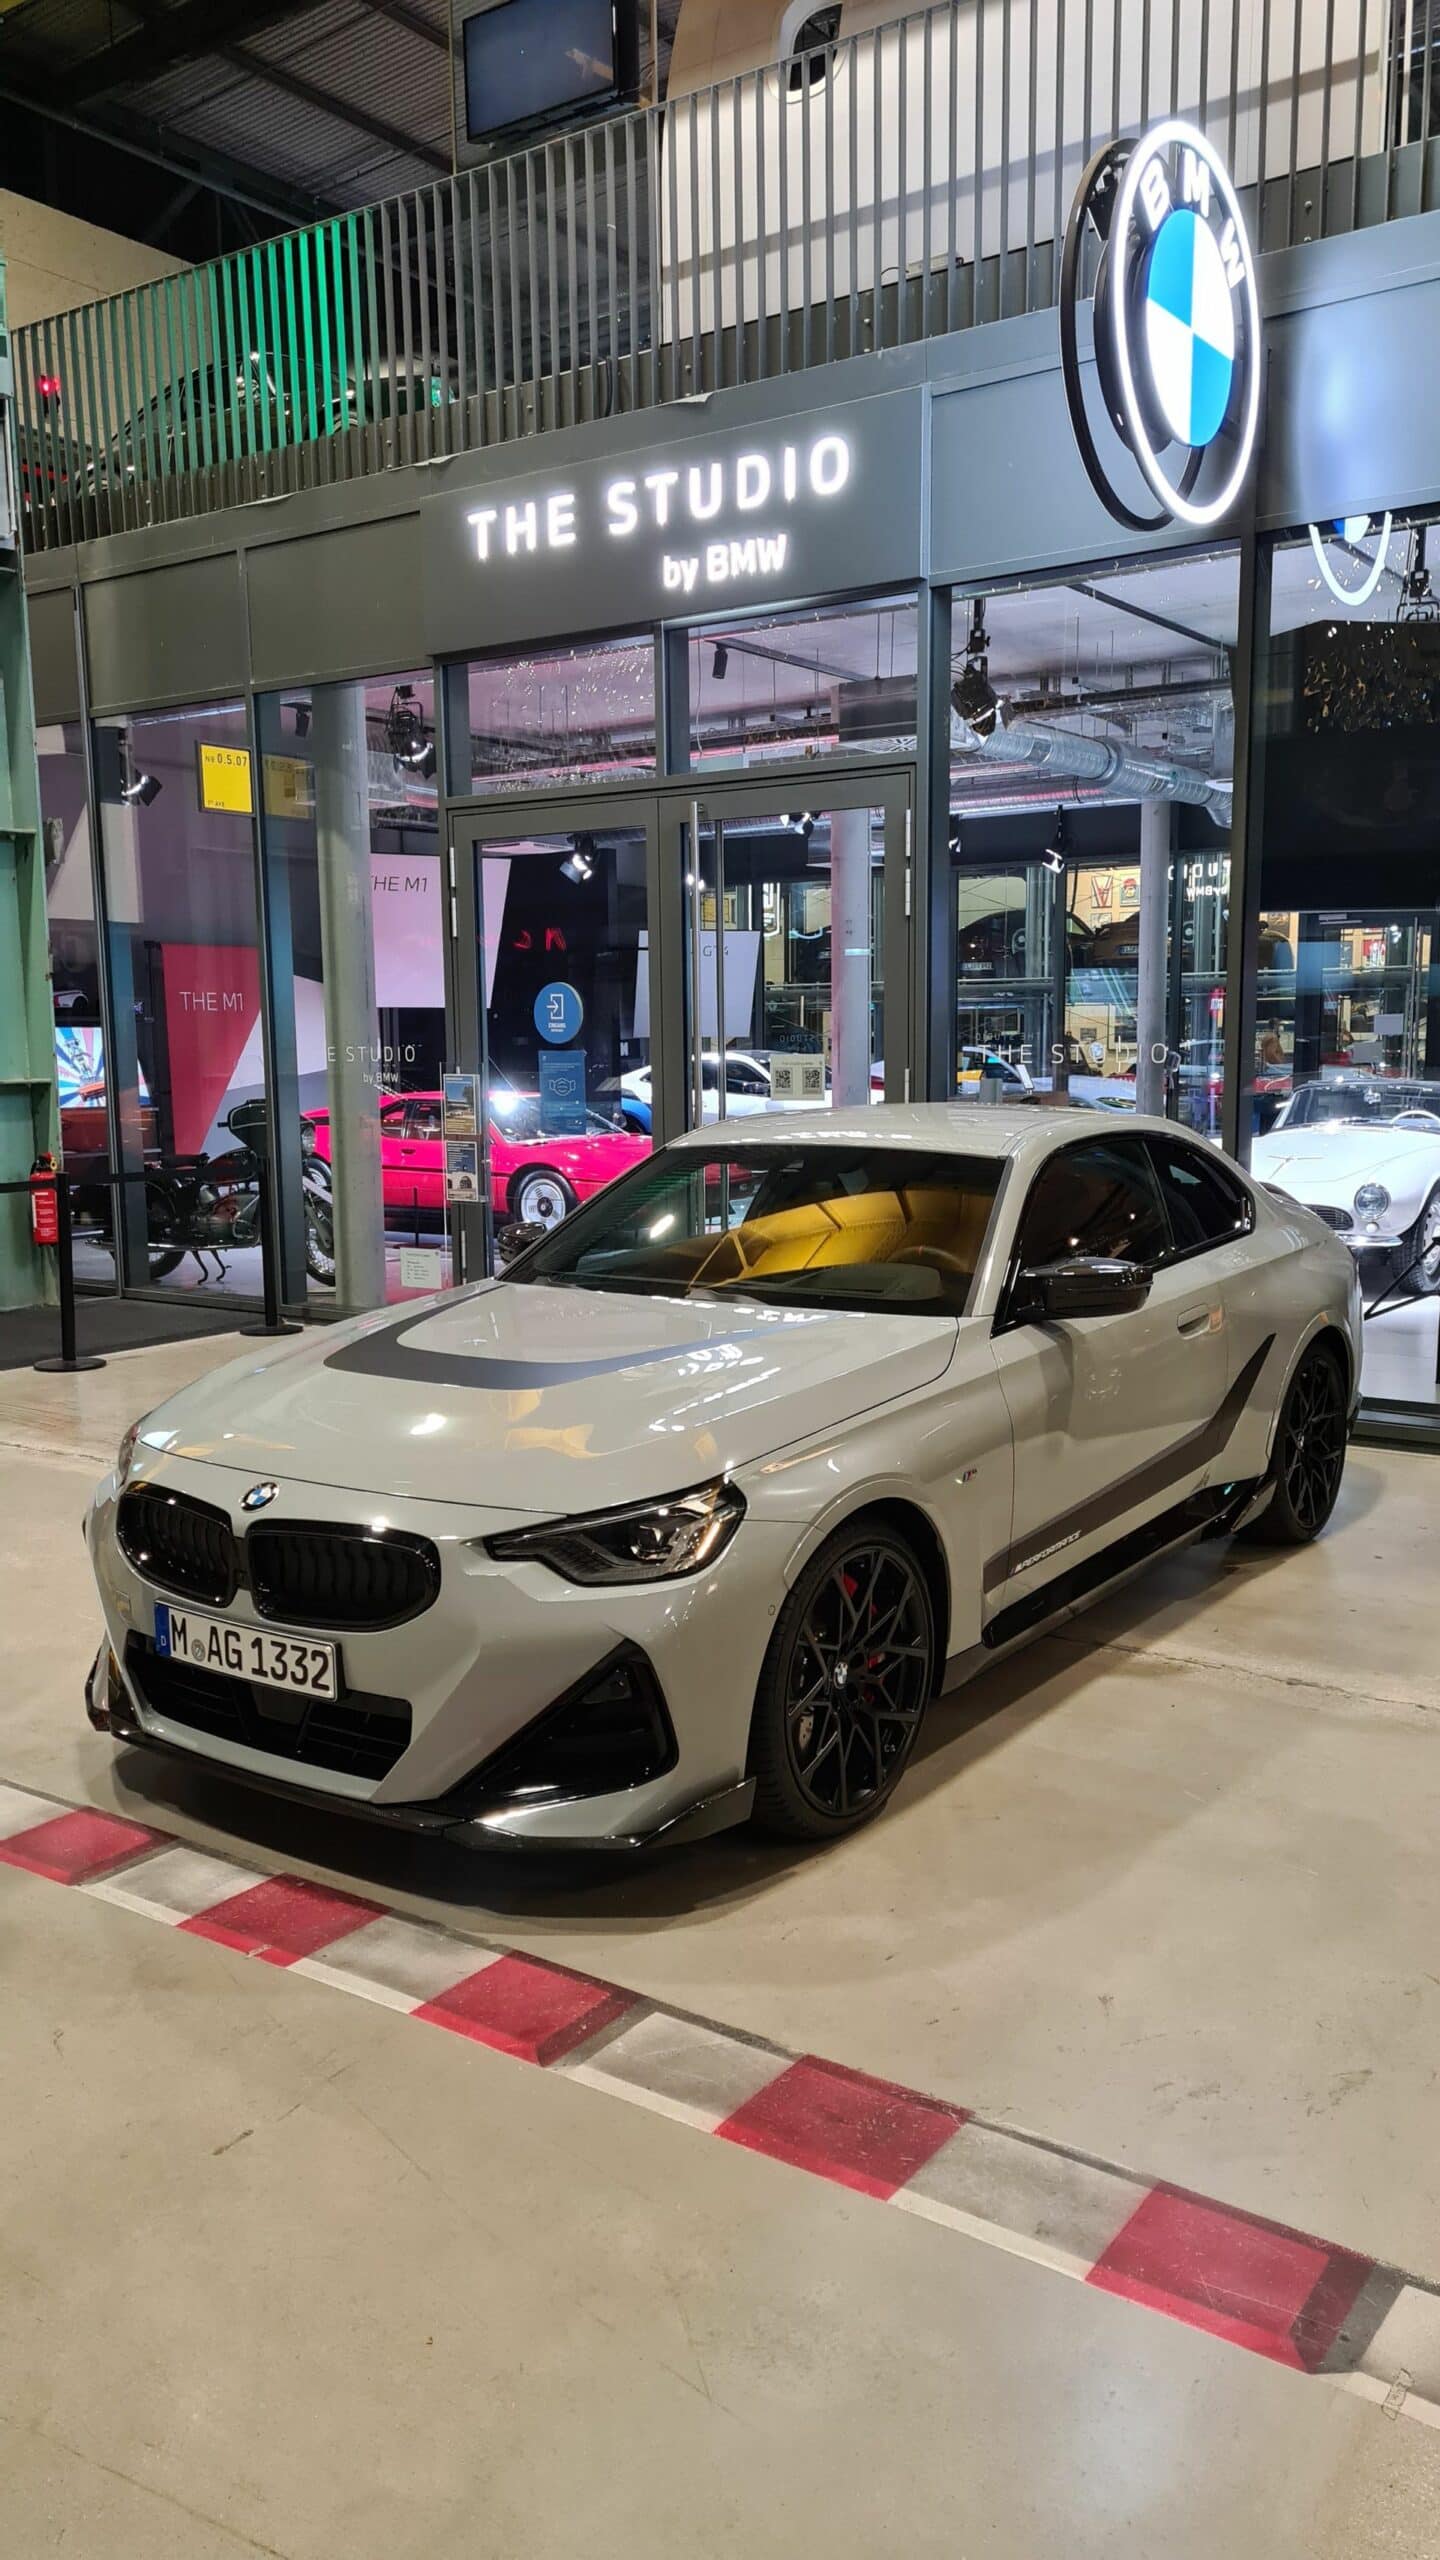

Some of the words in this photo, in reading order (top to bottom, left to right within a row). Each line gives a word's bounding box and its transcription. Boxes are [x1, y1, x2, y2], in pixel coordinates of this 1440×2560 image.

[1139, 148, 1247, 289] BMW
[466, 492, 577, 562] THE
[605, 435, 851, 537] STUDIO
[662, 554, 699, 593] by
[706, 532, 788, 585] BMW
[216, 752, 248, 767] 0.5.07
[371, 875, 400, 892] HE
[405, 876, 428, 893] M1
[178, 991, 218, 1012] THE
[223, 991, 244, 1013] M1
[345, 1046, 416, 1062] STUDIO
[978, 1043, 1033, 1064] THE
[1051, 1043, 1168, 1064] STUDIO
[376, 1072, 399, 1083] BMW
[160, 1635, 167, 1647] D
[171, 1613, 188, 1655] M
[207, 1626, 243, 1671] AG
[251, 1636, 330, 1692] 1332
